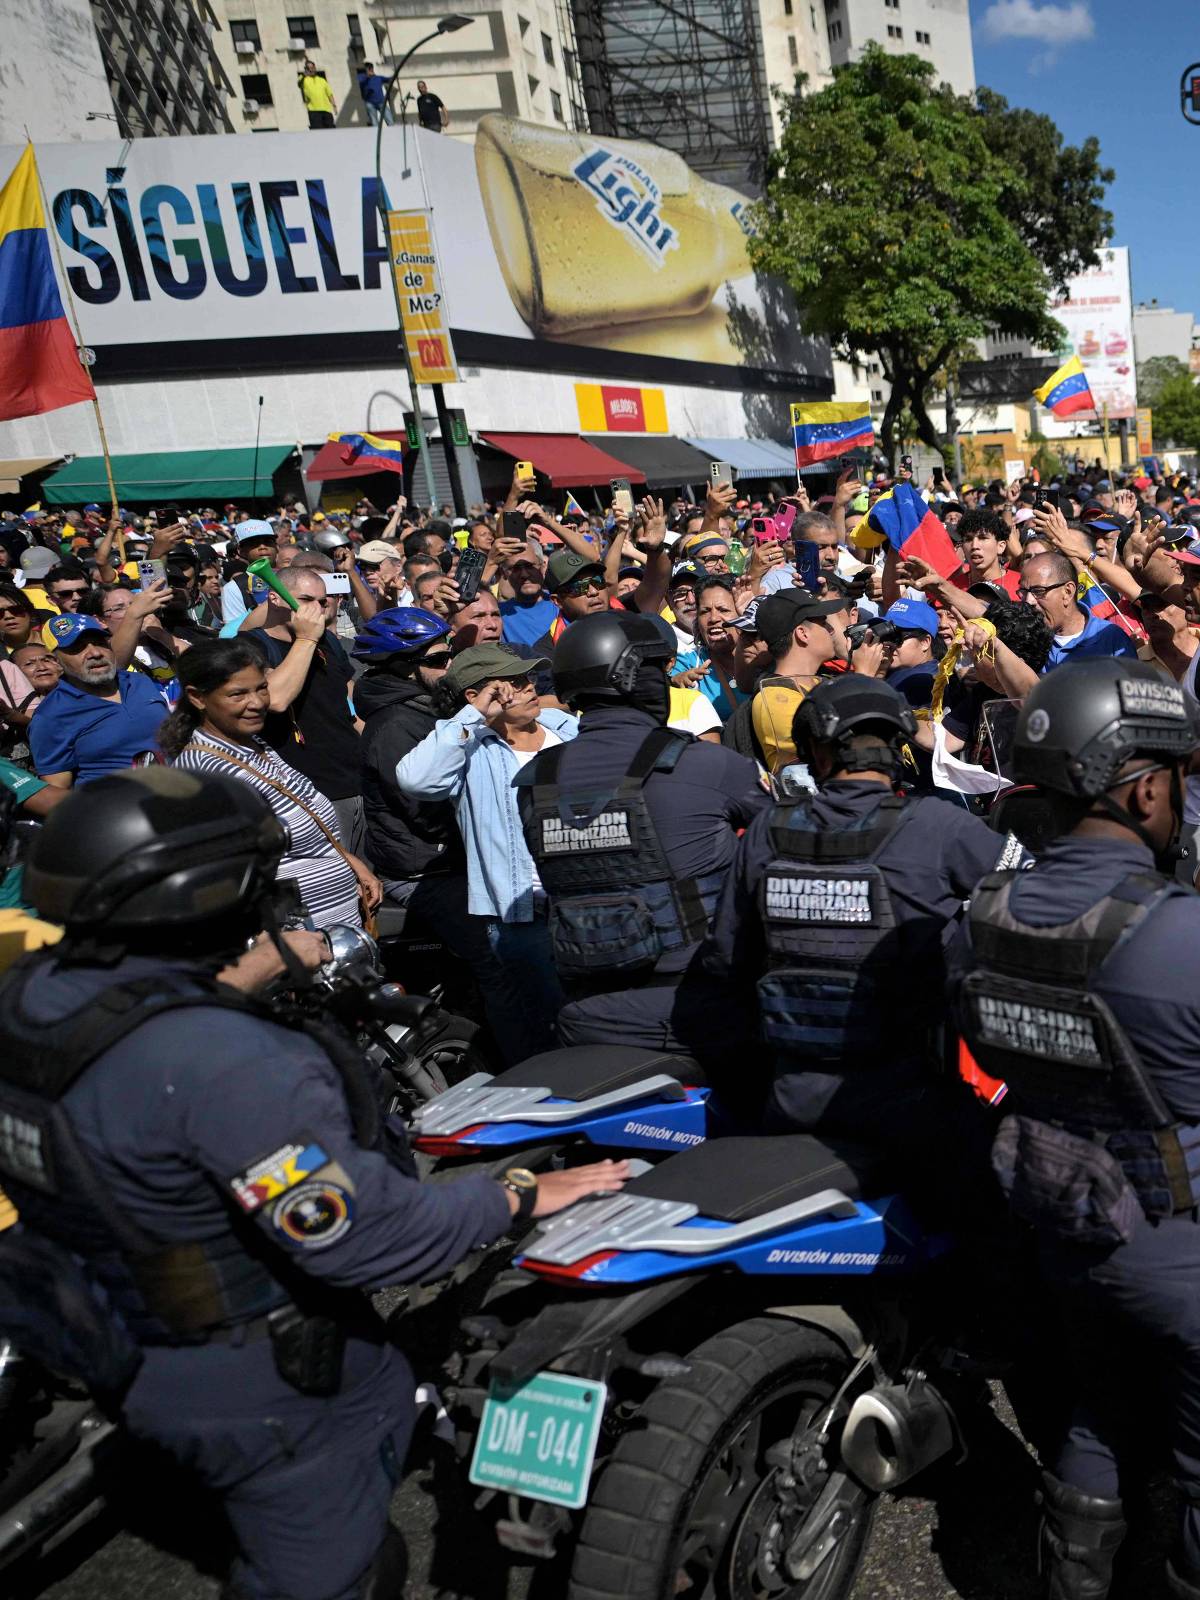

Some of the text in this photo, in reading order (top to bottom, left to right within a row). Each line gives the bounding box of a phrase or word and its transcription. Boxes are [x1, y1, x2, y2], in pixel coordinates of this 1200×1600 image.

[615, 157, 659, 200] POLAR
[574, 150, 673, 254] Light
[52, 166, 394, 305] SÍGUELA
[395, 252, 436, 265] ¿Ganas
[404, 272, 423, 287] de
[409, 294, 441, 313] Mc?
[1121, 680, 1184, 704] DIVISION
[543, 823, 630, 844] MOTORIZADA
[570, 841, 579, 850] DE
[580, 840, 590, 849] LA
[591, 836, 632, 849] PRECISION
[766, 877, 869, 896] DIVISION
[766, 892, 870, 912] MOTORIZADA
[798, 908, 809, 919] DE
[810, 909, 821, 920] LA
[624, 1121, 674, 1141] DIVISIÓN
[766, 1249, 831, 1264] DIVISIÓN
[487, 1406, 584, 1469] DM-044
